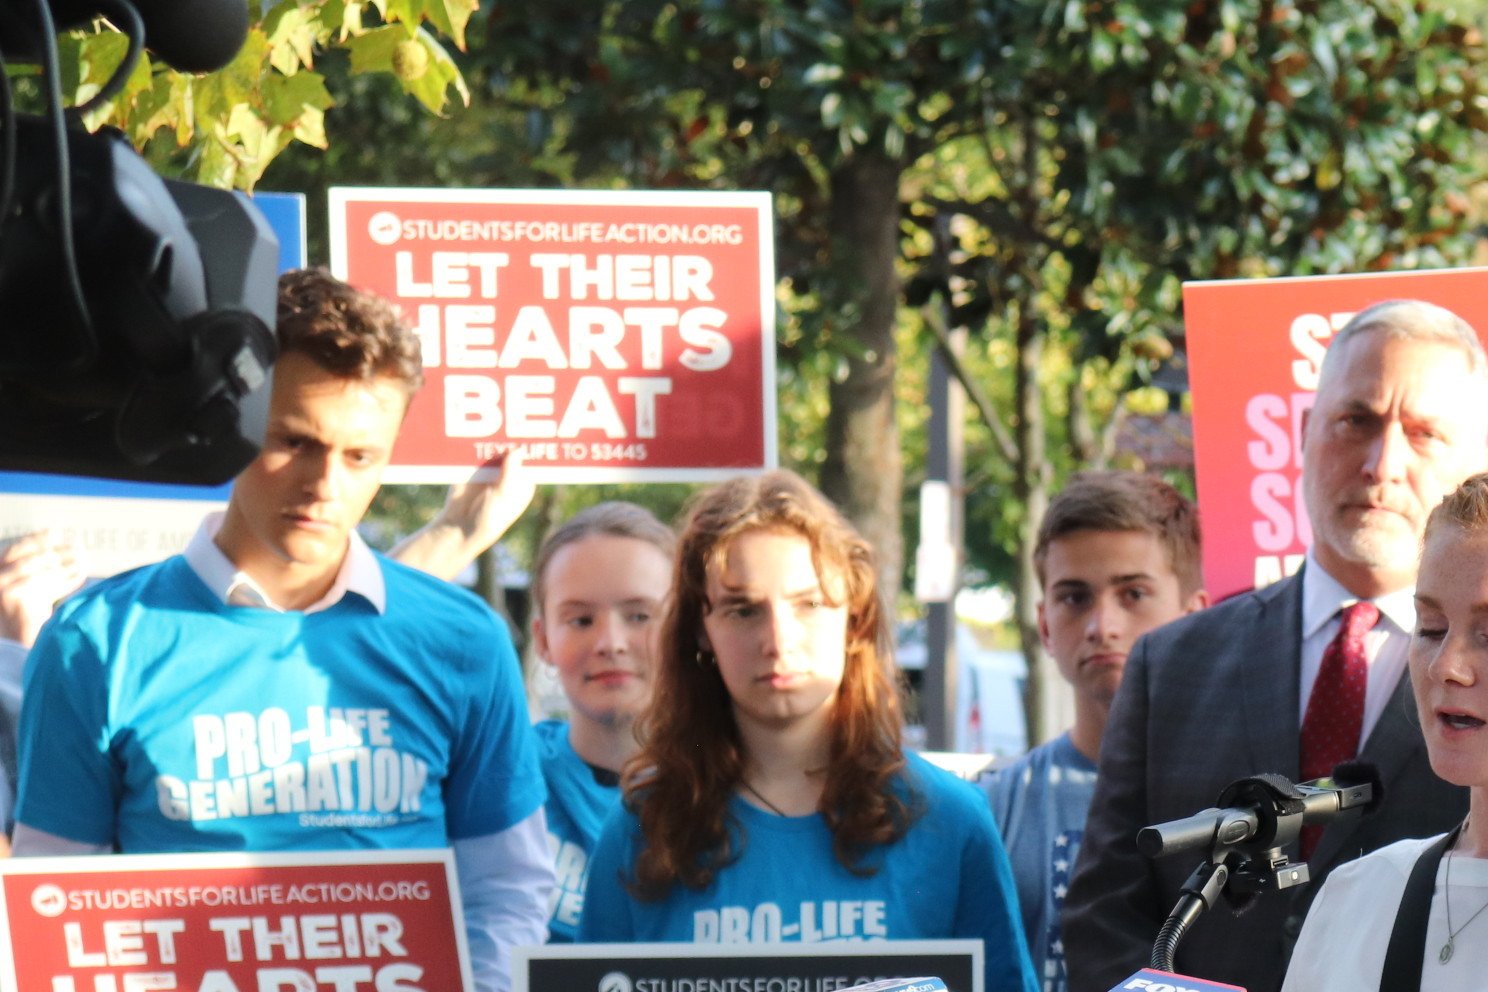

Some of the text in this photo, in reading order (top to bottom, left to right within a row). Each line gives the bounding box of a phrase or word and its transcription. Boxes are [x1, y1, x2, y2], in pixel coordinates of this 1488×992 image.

[403, 218, 743, 246] STUDENTSFORLIFEACTION.ORG
[395, 250, 715, 301] LET THEIR
[443, 374, 672, 439] BEAT
[523, 444, 558, 461] LIFE
[563, 444, 587, 460] TO
[590, 444, 647, 461] 53445
[192, 704, 395, 781] PRO-LIFE
[155, 746, 429, 823] GENERATION
[67, 880, 431, 911] STUDENTSFORLIFEACTION.ORG
[63, 911, 408, 969] LET THEIR
